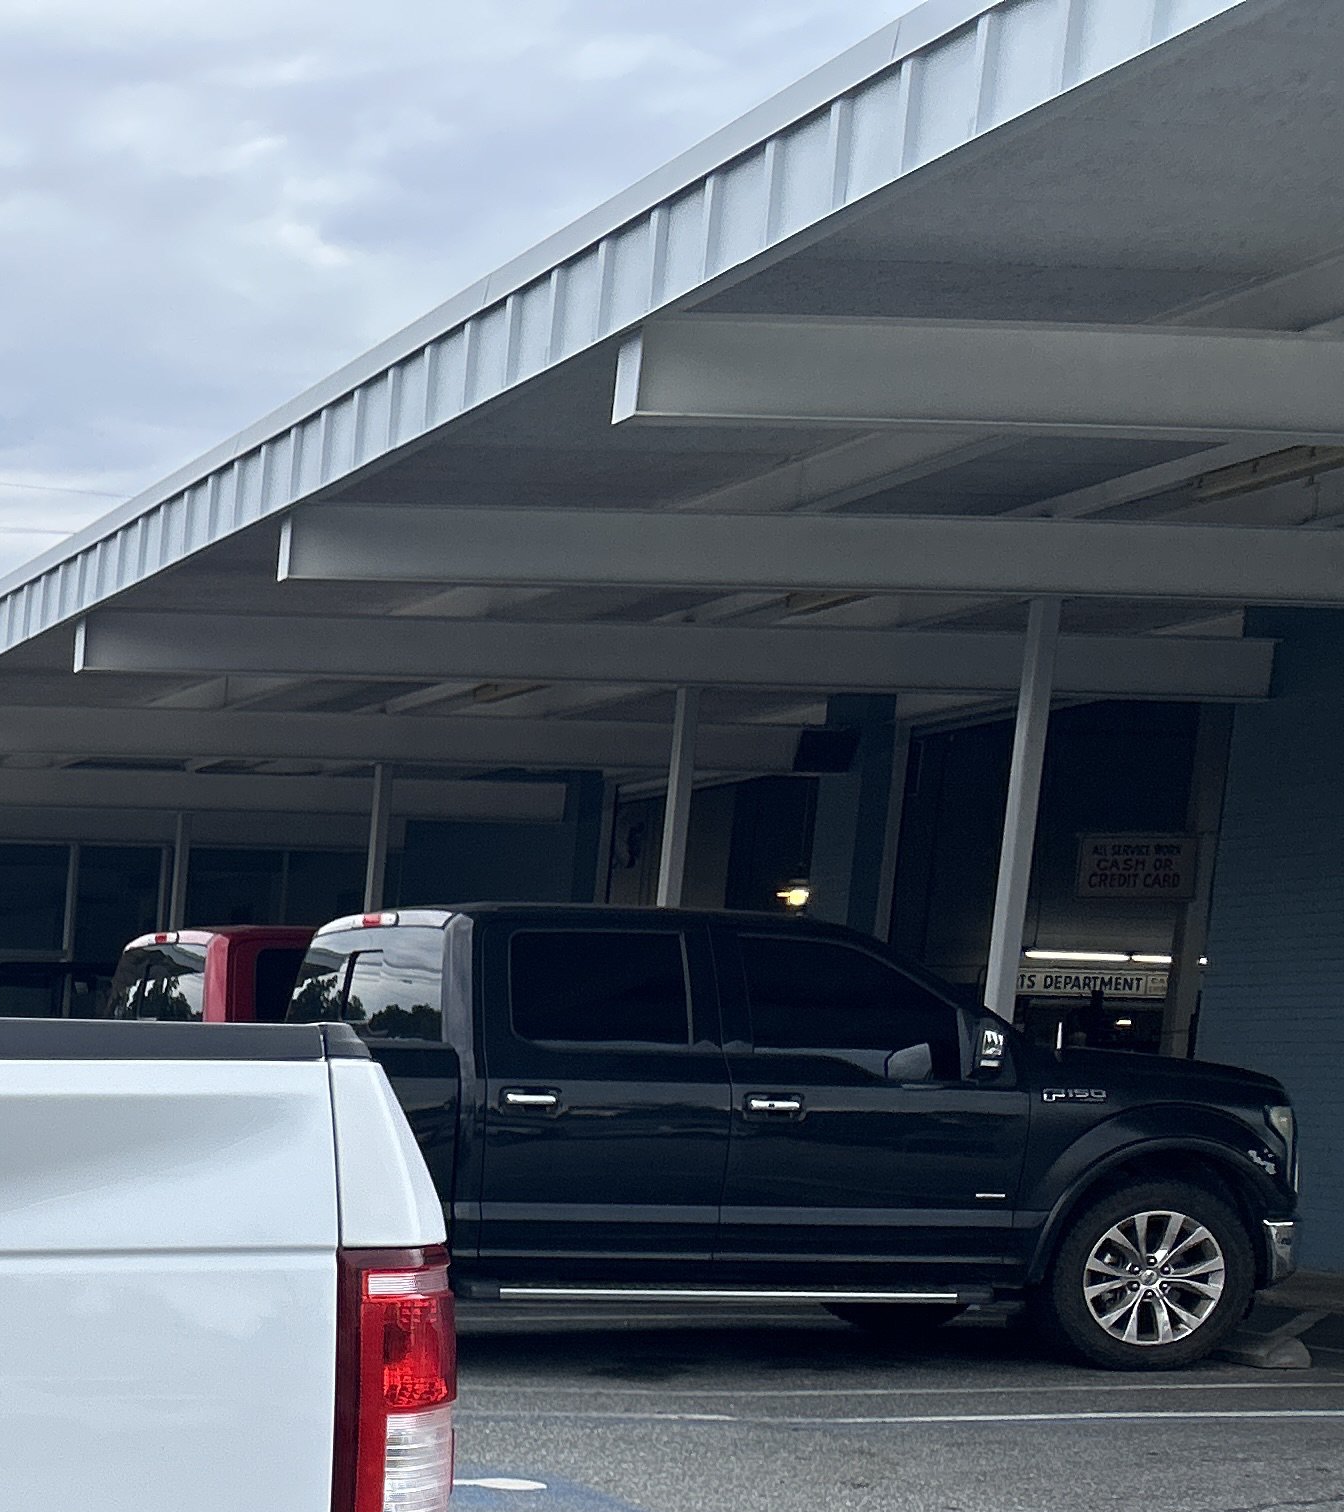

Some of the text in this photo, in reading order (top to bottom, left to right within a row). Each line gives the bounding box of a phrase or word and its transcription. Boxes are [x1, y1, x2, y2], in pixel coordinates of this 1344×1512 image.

[1096, 858, 1174, 871] CASH OR
[1087, 872, 1180, 888] CREDIT CARD
[1043, 974, 1143, 992] DEPARTMENT
